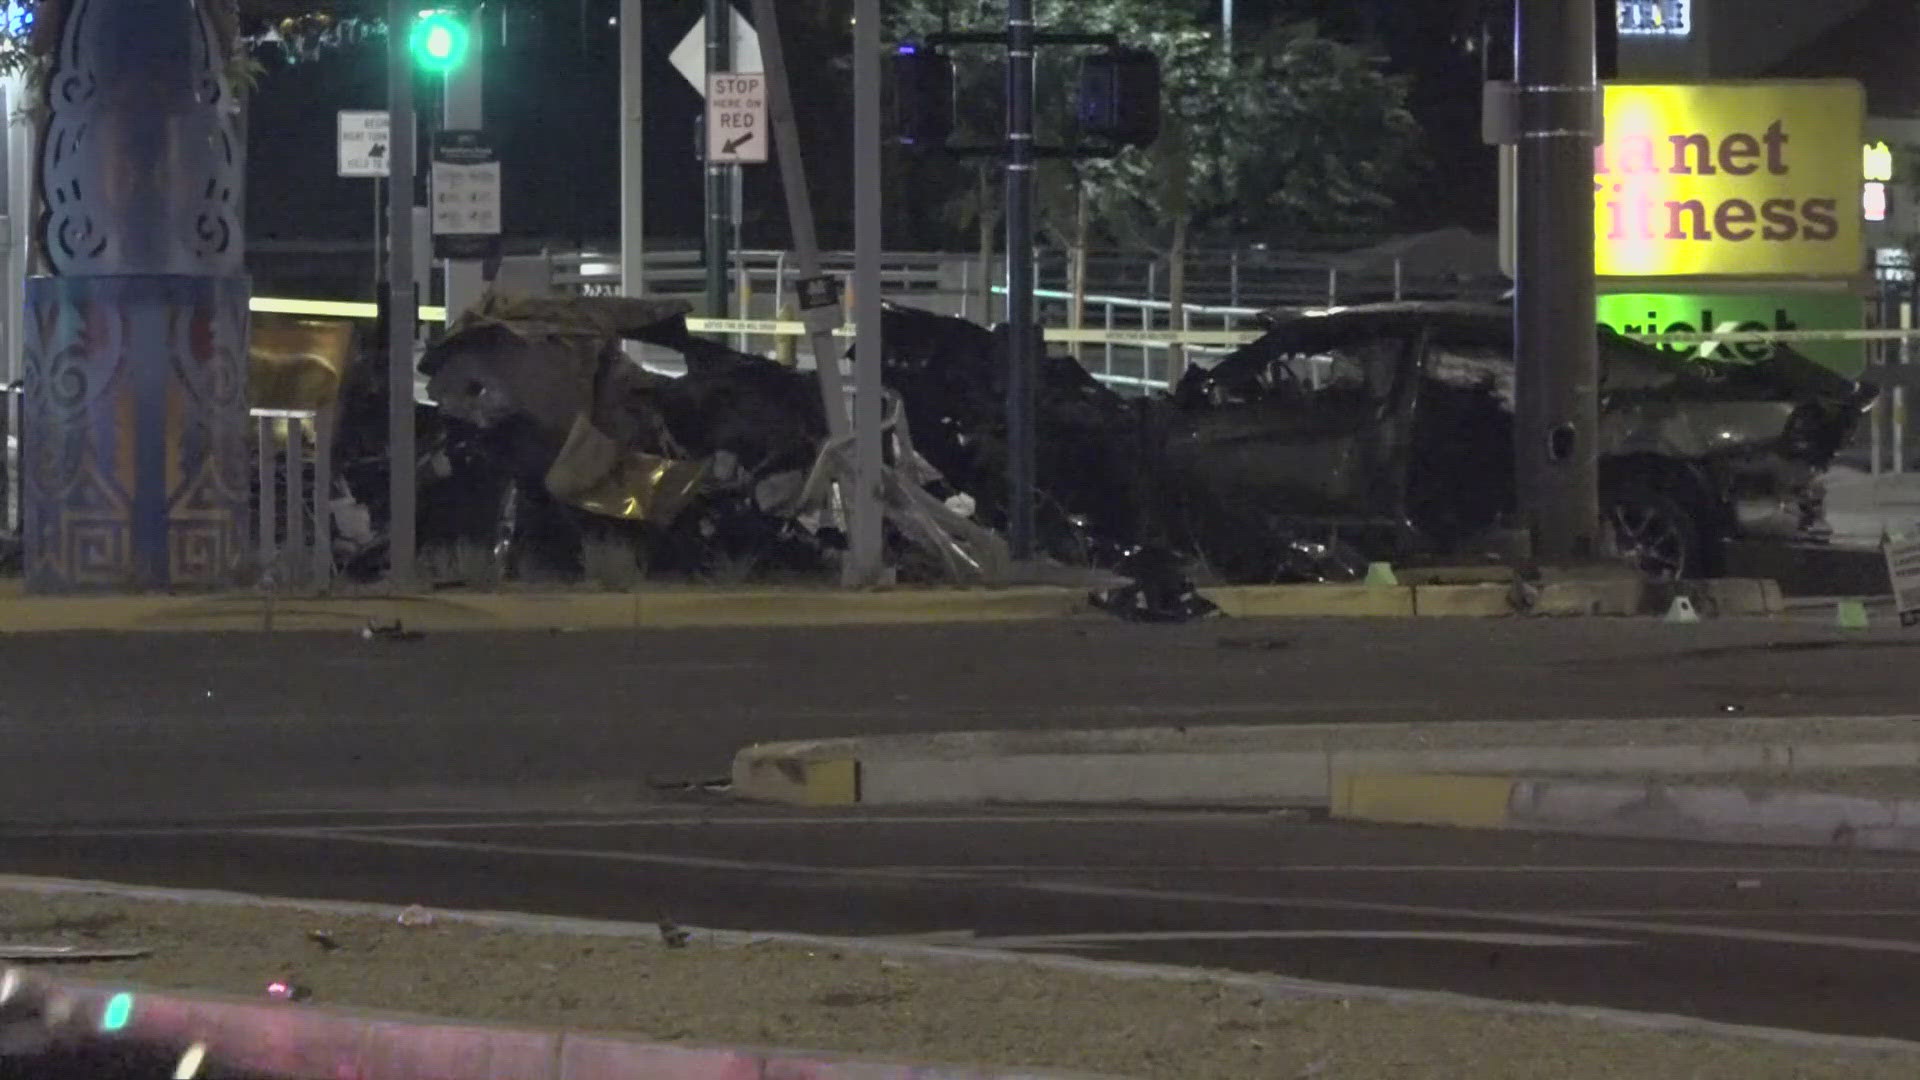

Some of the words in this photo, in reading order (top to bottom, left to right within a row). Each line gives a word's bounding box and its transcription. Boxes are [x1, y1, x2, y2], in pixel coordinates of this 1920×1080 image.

[715, 79, 759, 94] STOP
[721, 113, 754, 128] RED
[1594, 119, 1789, 175] lanet
[1594, 181, 1838, 241] itness
